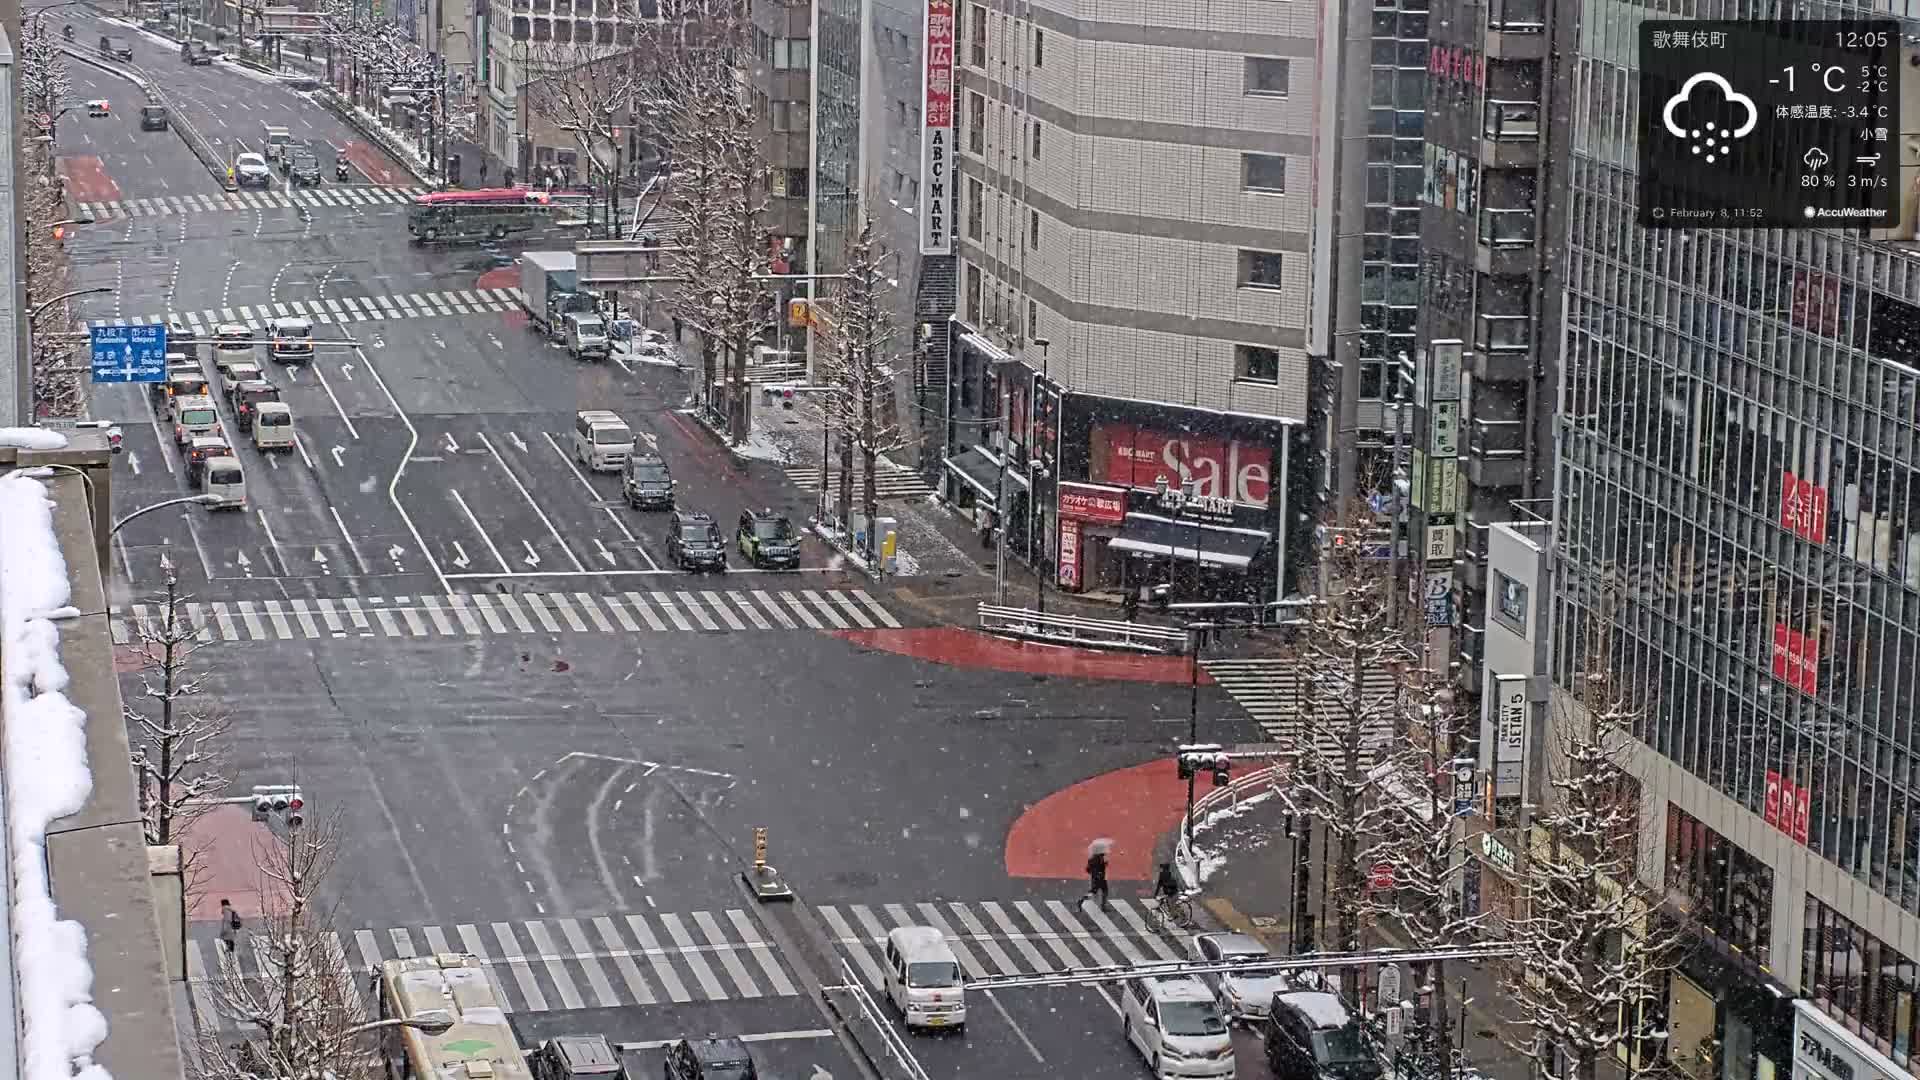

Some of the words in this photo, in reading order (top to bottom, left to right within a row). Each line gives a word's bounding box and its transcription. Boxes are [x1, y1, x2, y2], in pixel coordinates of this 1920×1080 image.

[929, 14, 951, 96] 歌広場
[96, 327, 126, 337] 九段下
[1163, 438, 1269, 506] Sale
[1062, 494, 1088, 507] カラオケ
[1786, 485, 1822, 533] 会計
[1431, 529, 1445, 556] 買取
[1511, 693, 1524, 704] 5
[1502, 704, 1510, 723] CITY
[1509, 707, 1523, 748] ISETAN
